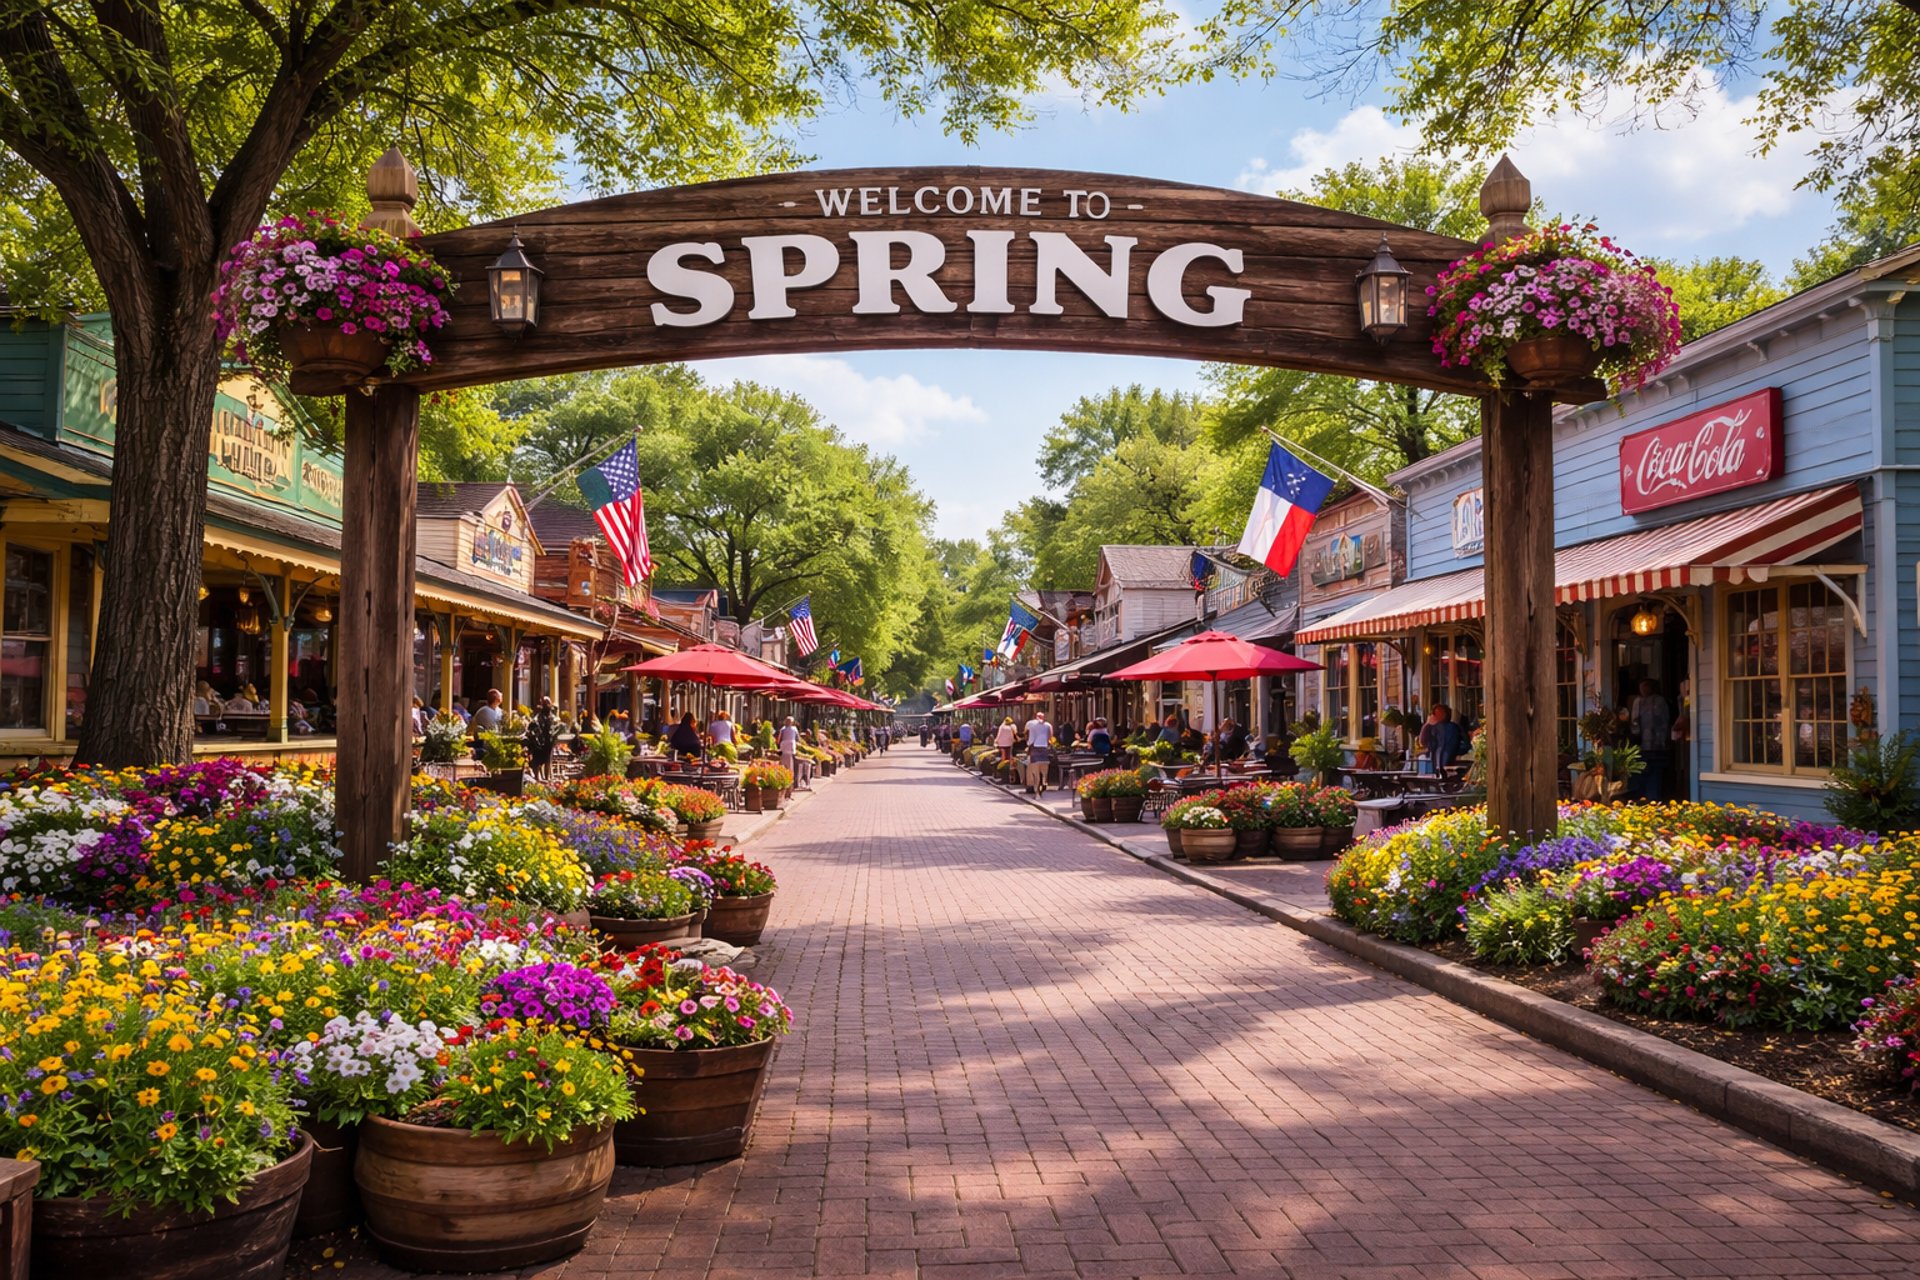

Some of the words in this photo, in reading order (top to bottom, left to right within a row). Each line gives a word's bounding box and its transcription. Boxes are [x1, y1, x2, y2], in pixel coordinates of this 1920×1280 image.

[815, 186, 1042, 217] WELCOME
[1064, 189, 1111, 220] TO
[646, 230, 1252, 328] SPRING
